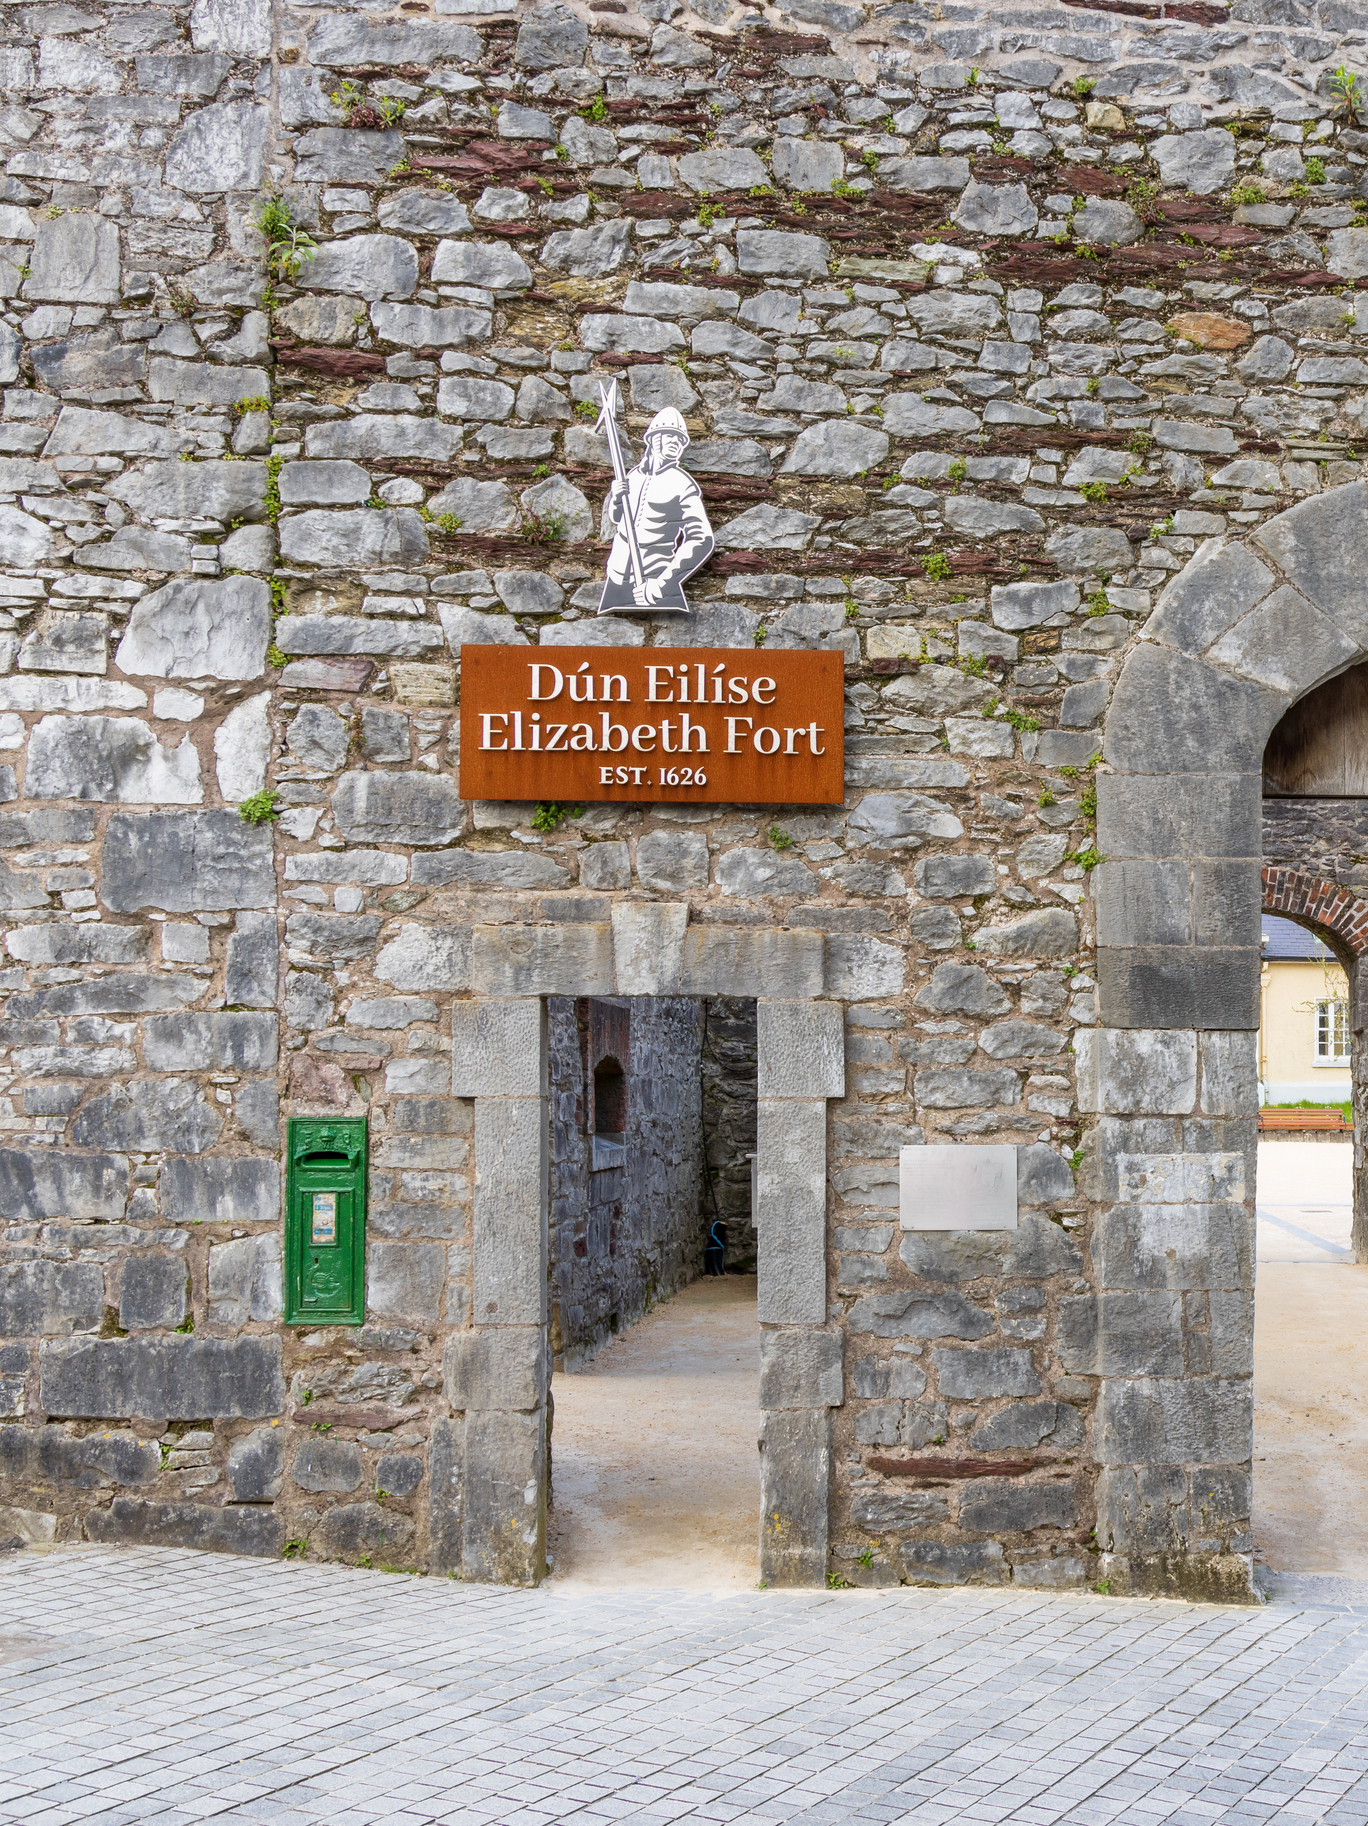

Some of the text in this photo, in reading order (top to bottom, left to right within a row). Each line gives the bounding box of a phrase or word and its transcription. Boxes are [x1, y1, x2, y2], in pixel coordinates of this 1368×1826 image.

[527, 661, 777, 704] Dún Eilíse
[478, 711, 825, 755] Elizabeth Fort
[599, 766, 707, 787] EST. 1626
